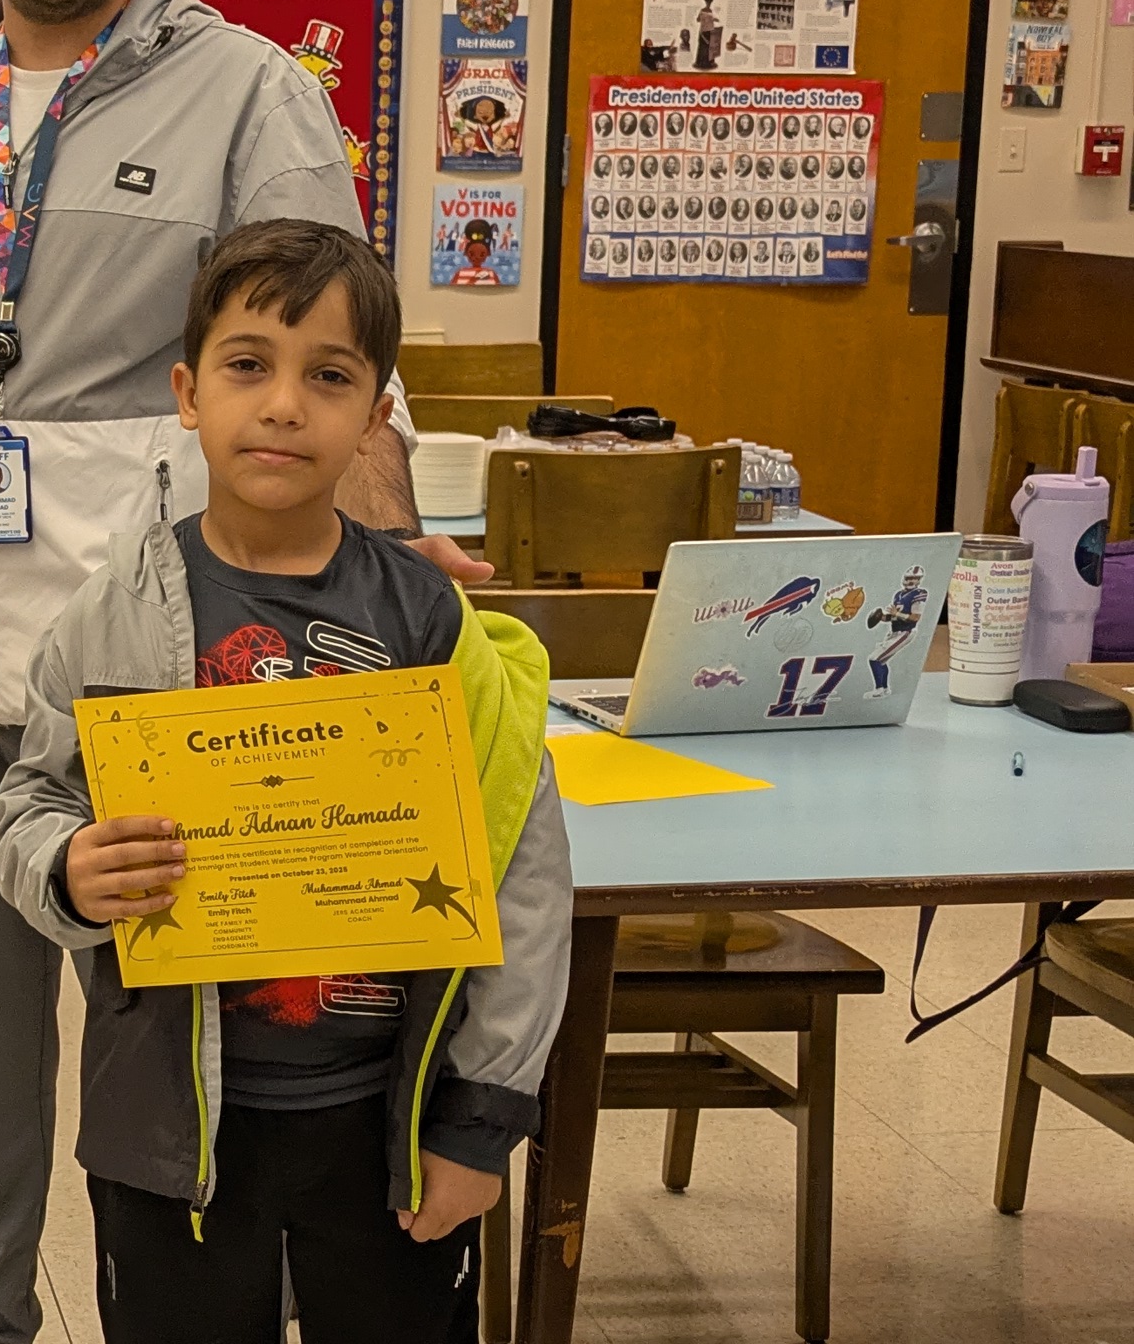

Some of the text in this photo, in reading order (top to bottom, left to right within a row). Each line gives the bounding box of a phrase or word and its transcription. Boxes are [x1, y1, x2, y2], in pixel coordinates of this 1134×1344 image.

[462, 69, 512, 79] GRACE
[456, 86, 515, 101] PRESIDENT
[611, 89, 860, 106] Presidents of the United States
[458, 189, 467, 198] V
[441, 200, 517, 217] VOTING
[974, 586, 982, 600] Kill
[973, 602, 981, 623] Devil
[766, 655, 854, 718] 17
[187, 721, 344, 753] Certificate
[211, 747, 326, 767] OF ACHIEVEMENT
[240, 811, 316, 836] Adnan
[322, 802, 419, 829] Hamada
[301, 877, 403, 895] Muhammad Ahmad
[198, 888, 257, 903] Emily Fitch
[315, 894, 399, 907] Muhammad Ahmad
[208, 907, 251, 917] Emily Fitch
